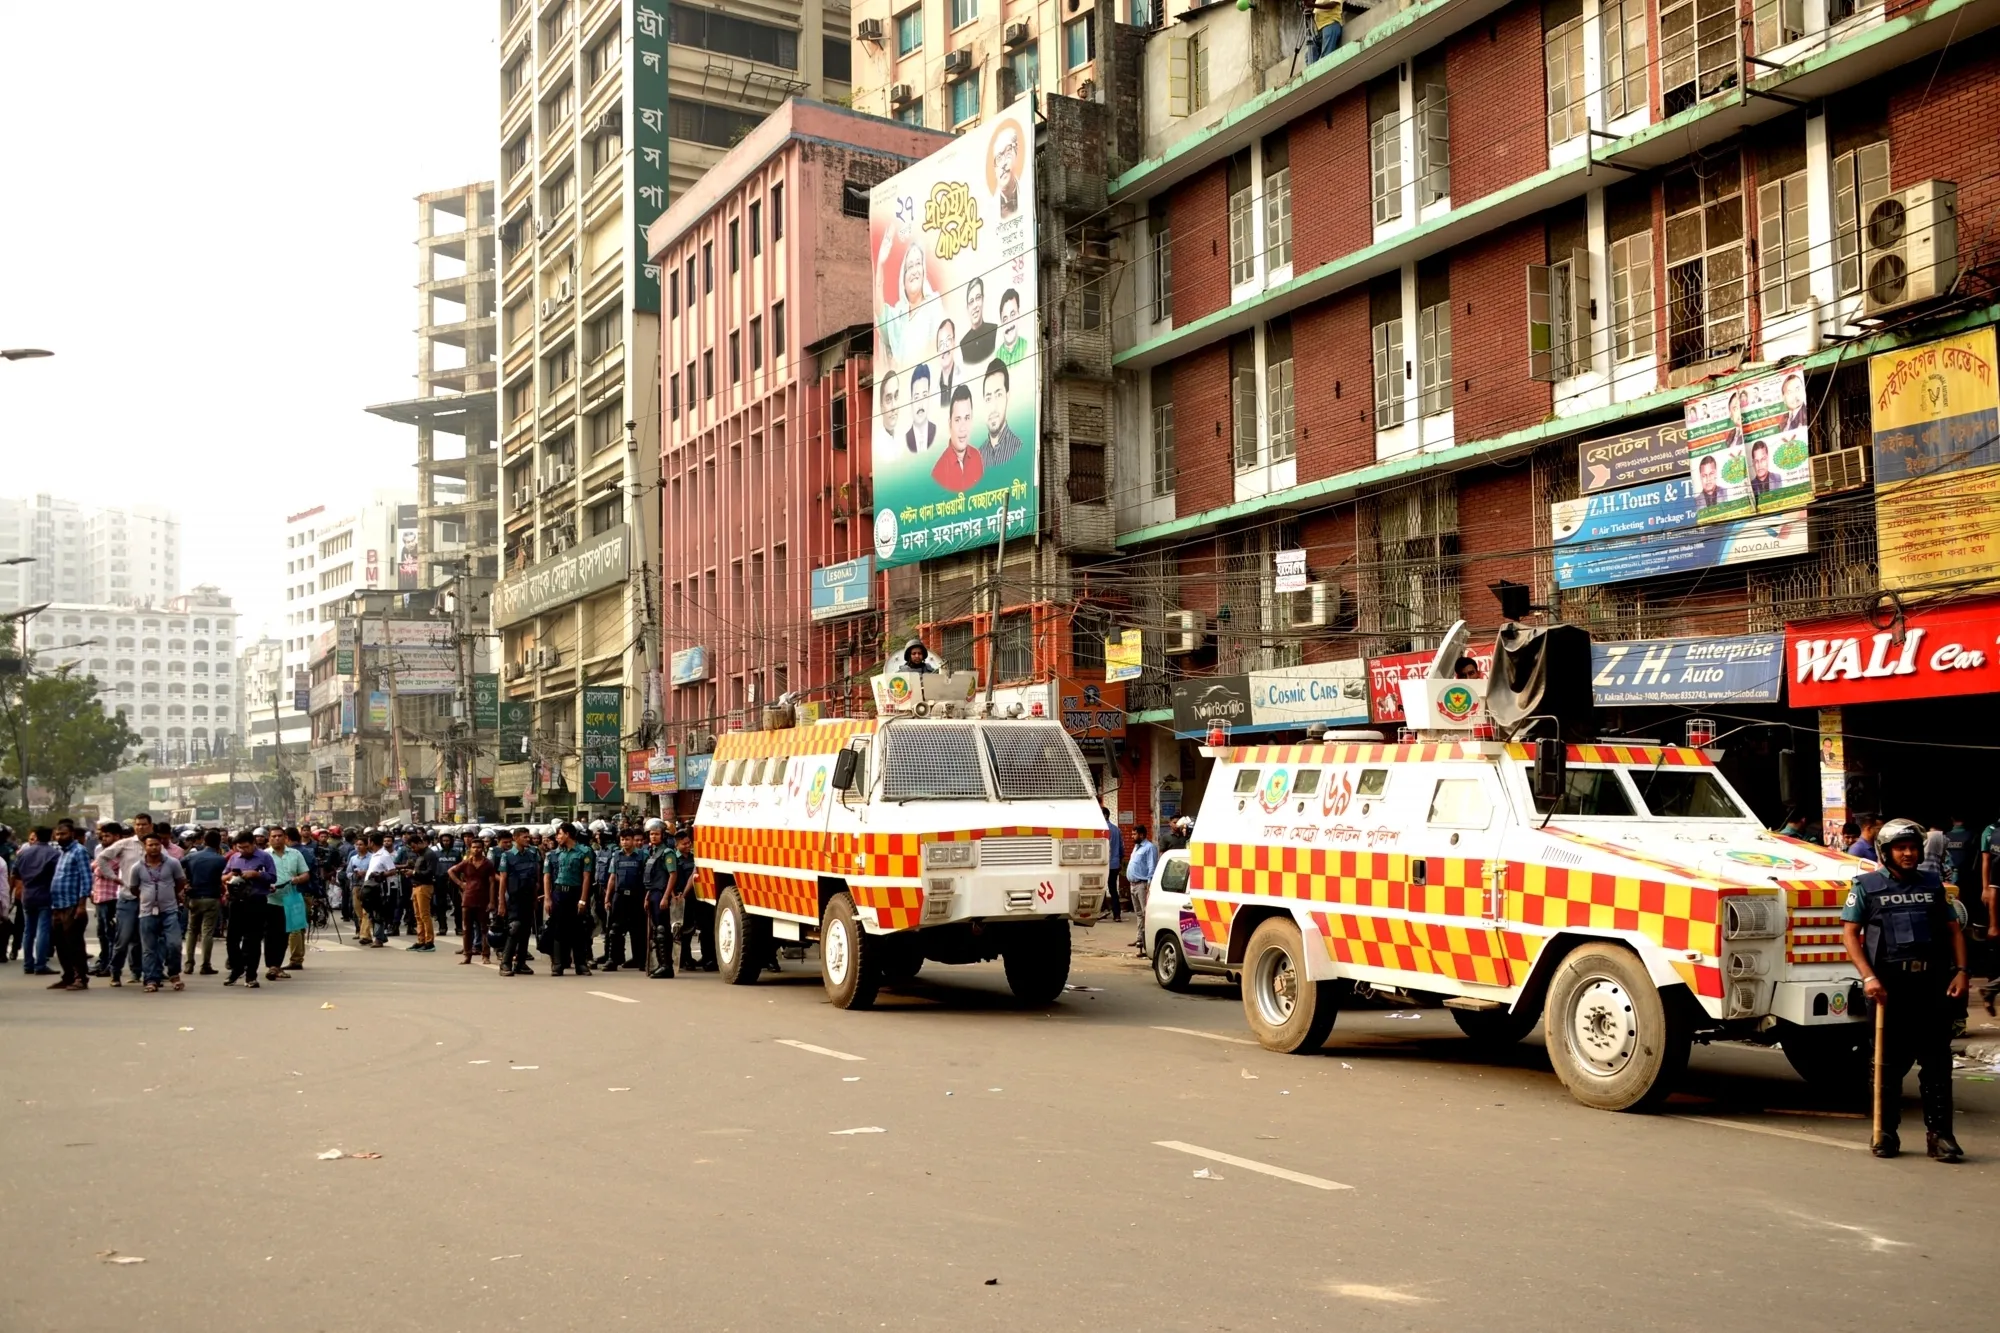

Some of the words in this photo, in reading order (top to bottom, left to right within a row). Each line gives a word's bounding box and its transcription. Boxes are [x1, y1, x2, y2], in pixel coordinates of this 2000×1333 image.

[638, 107, 662, 286] হাসপাল
[1587, 436, 1652, 463] হোটেল
[1616, 470, 1636, 480] ৩য়
[1639, 462, 1674, 475] তলায়
[919, 504, 934, 522] থানা
[936, 491, 966, 516] আওয়ামী
[1011, 478, 1028, 502] লীগ
[1664, 484, 1678, 502] &
[901, 528, 930, 550] ঢাকা
[932, 517, 983, 546] মহানগর
[1599, 526, 1610, 535] Air
[1611, 520, 1644, 534] Ticketing
[1656, 512, 1684, 526] Package
[1734, 541, 1780, 554] NOVOAIR
[1900, 550, 1943, 563] পরিবেশন
[1947, 547, 1966, 557] করা
[529, 570, 550, 602] ব্যাংক
[579, 537, 622, 583] হাসপাতাল
[1684, 640, 1774, 662] Enterprise
[1795, 628, 1926, 684] WALI
[1930, 643, 1985, 671] Car
[1372, 663, 1402, 694] ঢাকা
[1680, 667, 1724, 684] Auto
[586, 690, 618, 706] হাসপাতালে
[586, 712, 604, 726] প্রবেশ
[606, 712, 618, 728] পথ
[1323, 771, 1352, 817] ৬৯
[1264, 825, 1288, 838] ঢাকা
[1290, 824, 1320, 842] মেট্রো
[1324, 824, 1362, 842] পলিটন
[1366, 826, 1400, 848] পুলিশ
[1038, 881, 1054, 904] ২১
[1880, 893, 1934, 906] POLICE
